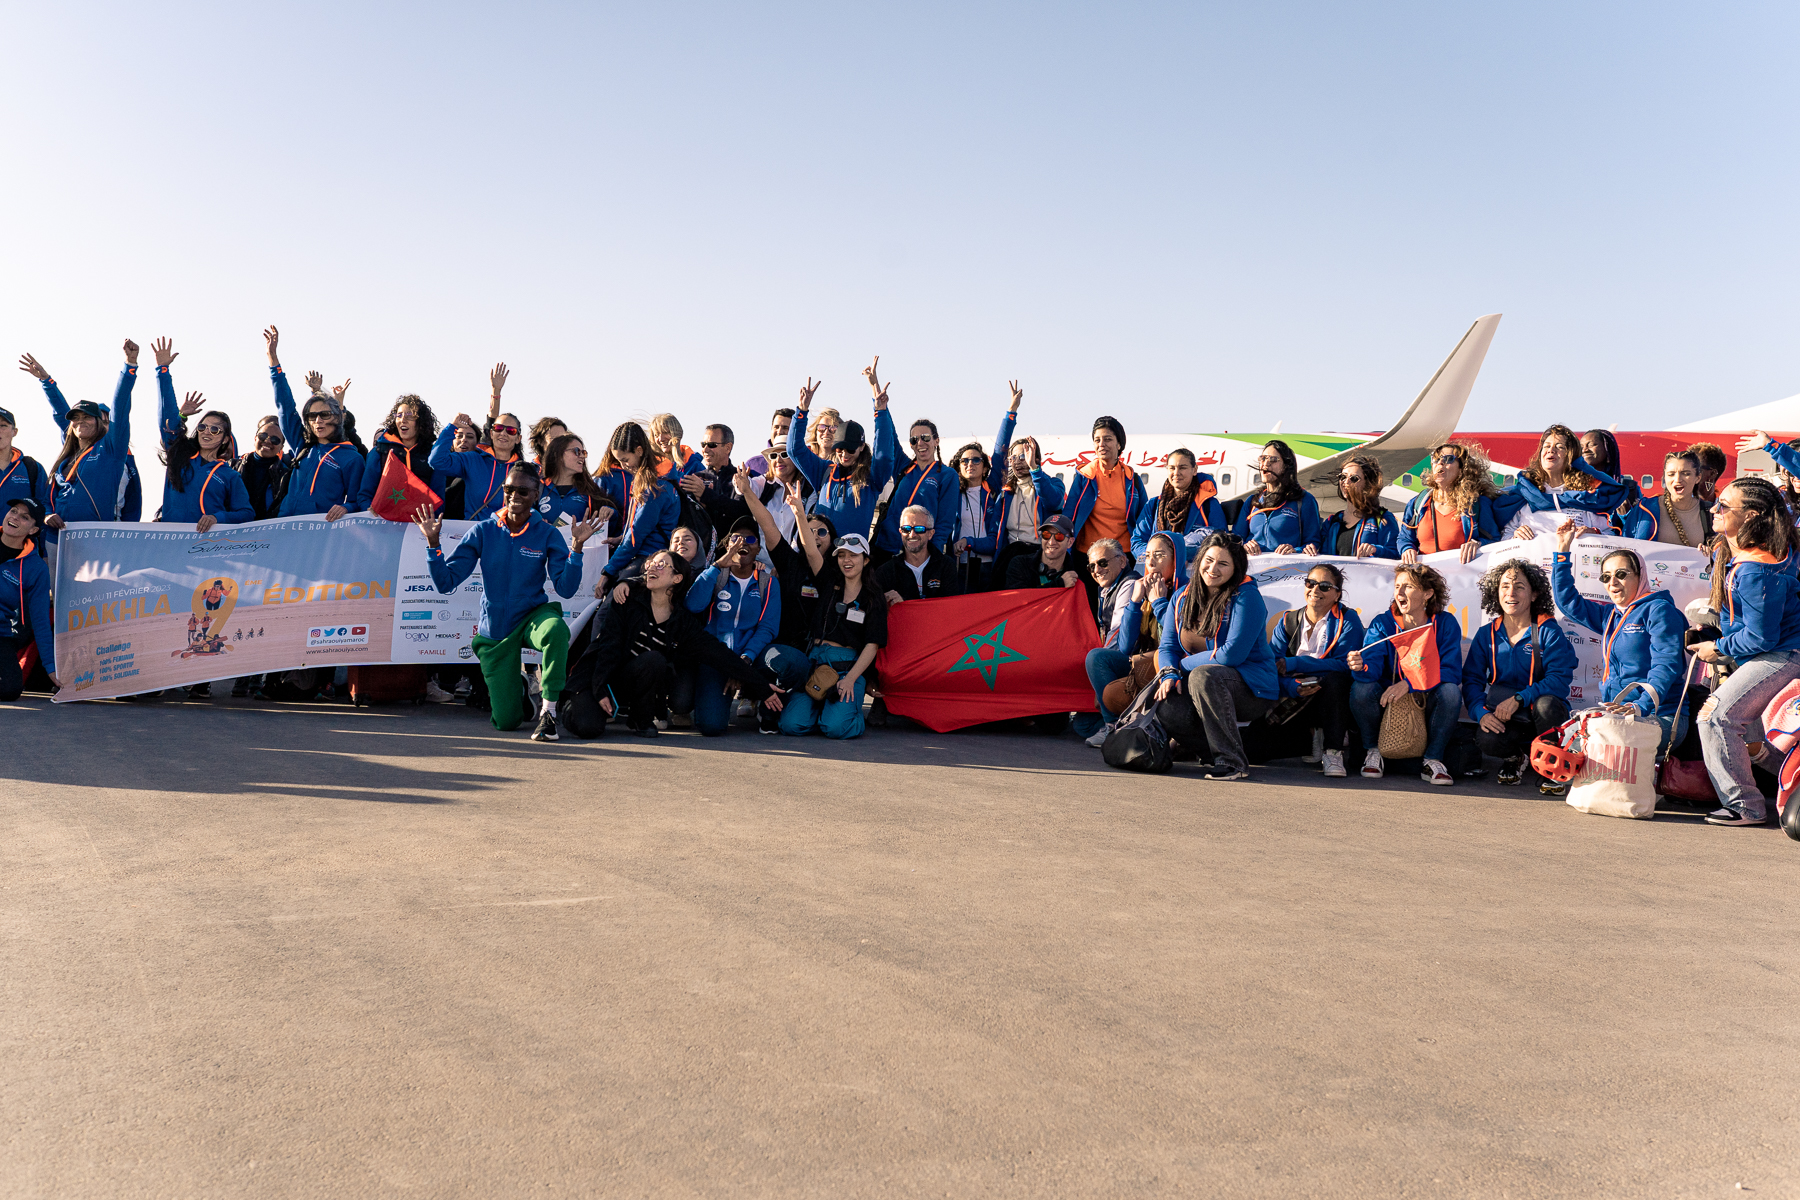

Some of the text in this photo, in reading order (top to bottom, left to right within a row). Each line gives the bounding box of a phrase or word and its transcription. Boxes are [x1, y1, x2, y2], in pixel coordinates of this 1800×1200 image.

[65, 530, 90, 541] SOUS
[94, 530, 107, 538] LE
[112, 531, 140, 540] HAUT
[144, 532, 204, 541] PATRONAGE
[242, 522, 286, 534] MAJESTÉ
[291, 522, 303, 531] LE
[308, 522, 326, 531] ROI
[331, 518, 387, 530] MOHAMMED
[188, 541, 271, 554] Sahraouiya
[69, 584, 171, 608] DU 04 AU 11 FÉVRIER 2023
[68, 594, 172, 632] DAKHLA
[191, 577, 239, 641] 9
[262, 580, 391, 605] ÉDITION
[310, 636, 365, 646] @sahraouiyamaroc
[96, 642, 131, 656] Challenge
[306, 646, 369, 656] www.sahraouiya.com
[99, 658, 112, 667] 100%
[99, 661, 134, 675] 100% SPORTIF
[99, 674, 113, 683] 100%
[113, 668, 140, 680] SOLIDAIRE
